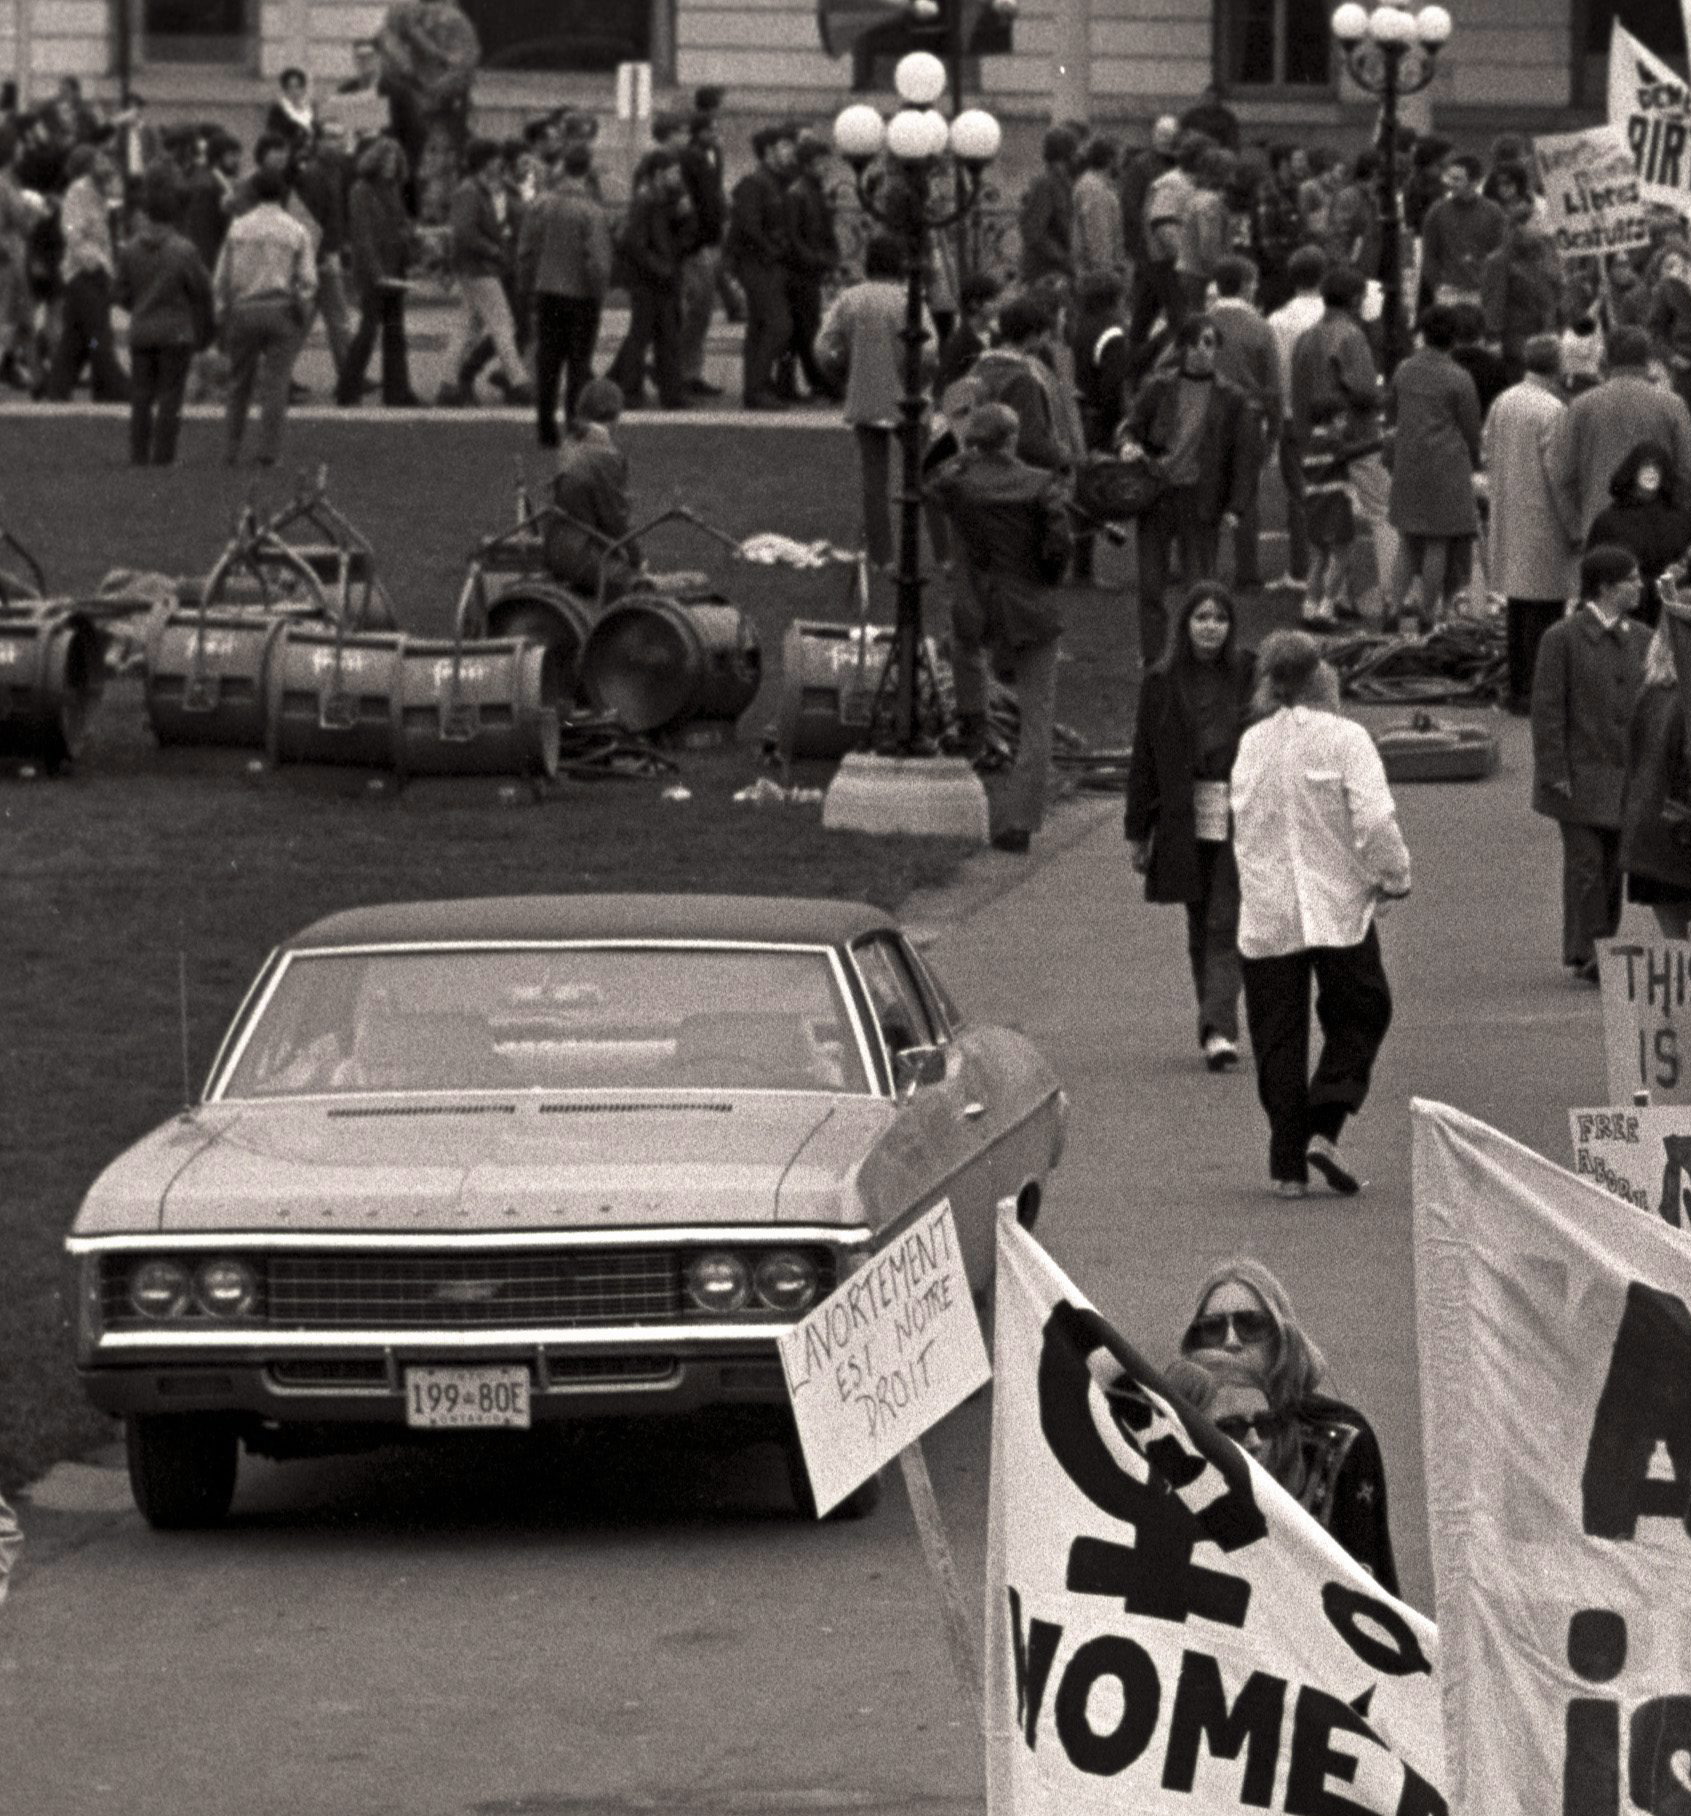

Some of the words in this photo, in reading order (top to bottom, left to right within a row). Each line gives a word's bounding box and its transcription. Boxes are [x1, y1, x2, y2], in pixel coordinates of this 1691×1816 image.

[1639, 1028, 1679, 1089] IS
[779, 1206, 952, 1398] L'AVORTEMENT
[835, 1342, 874, 1402] EST
[893, 1273, 955, 1340] NOTRE
[413, 1382, 459, 1414] 199
[854, 1339, 936, 1438] DROIT
